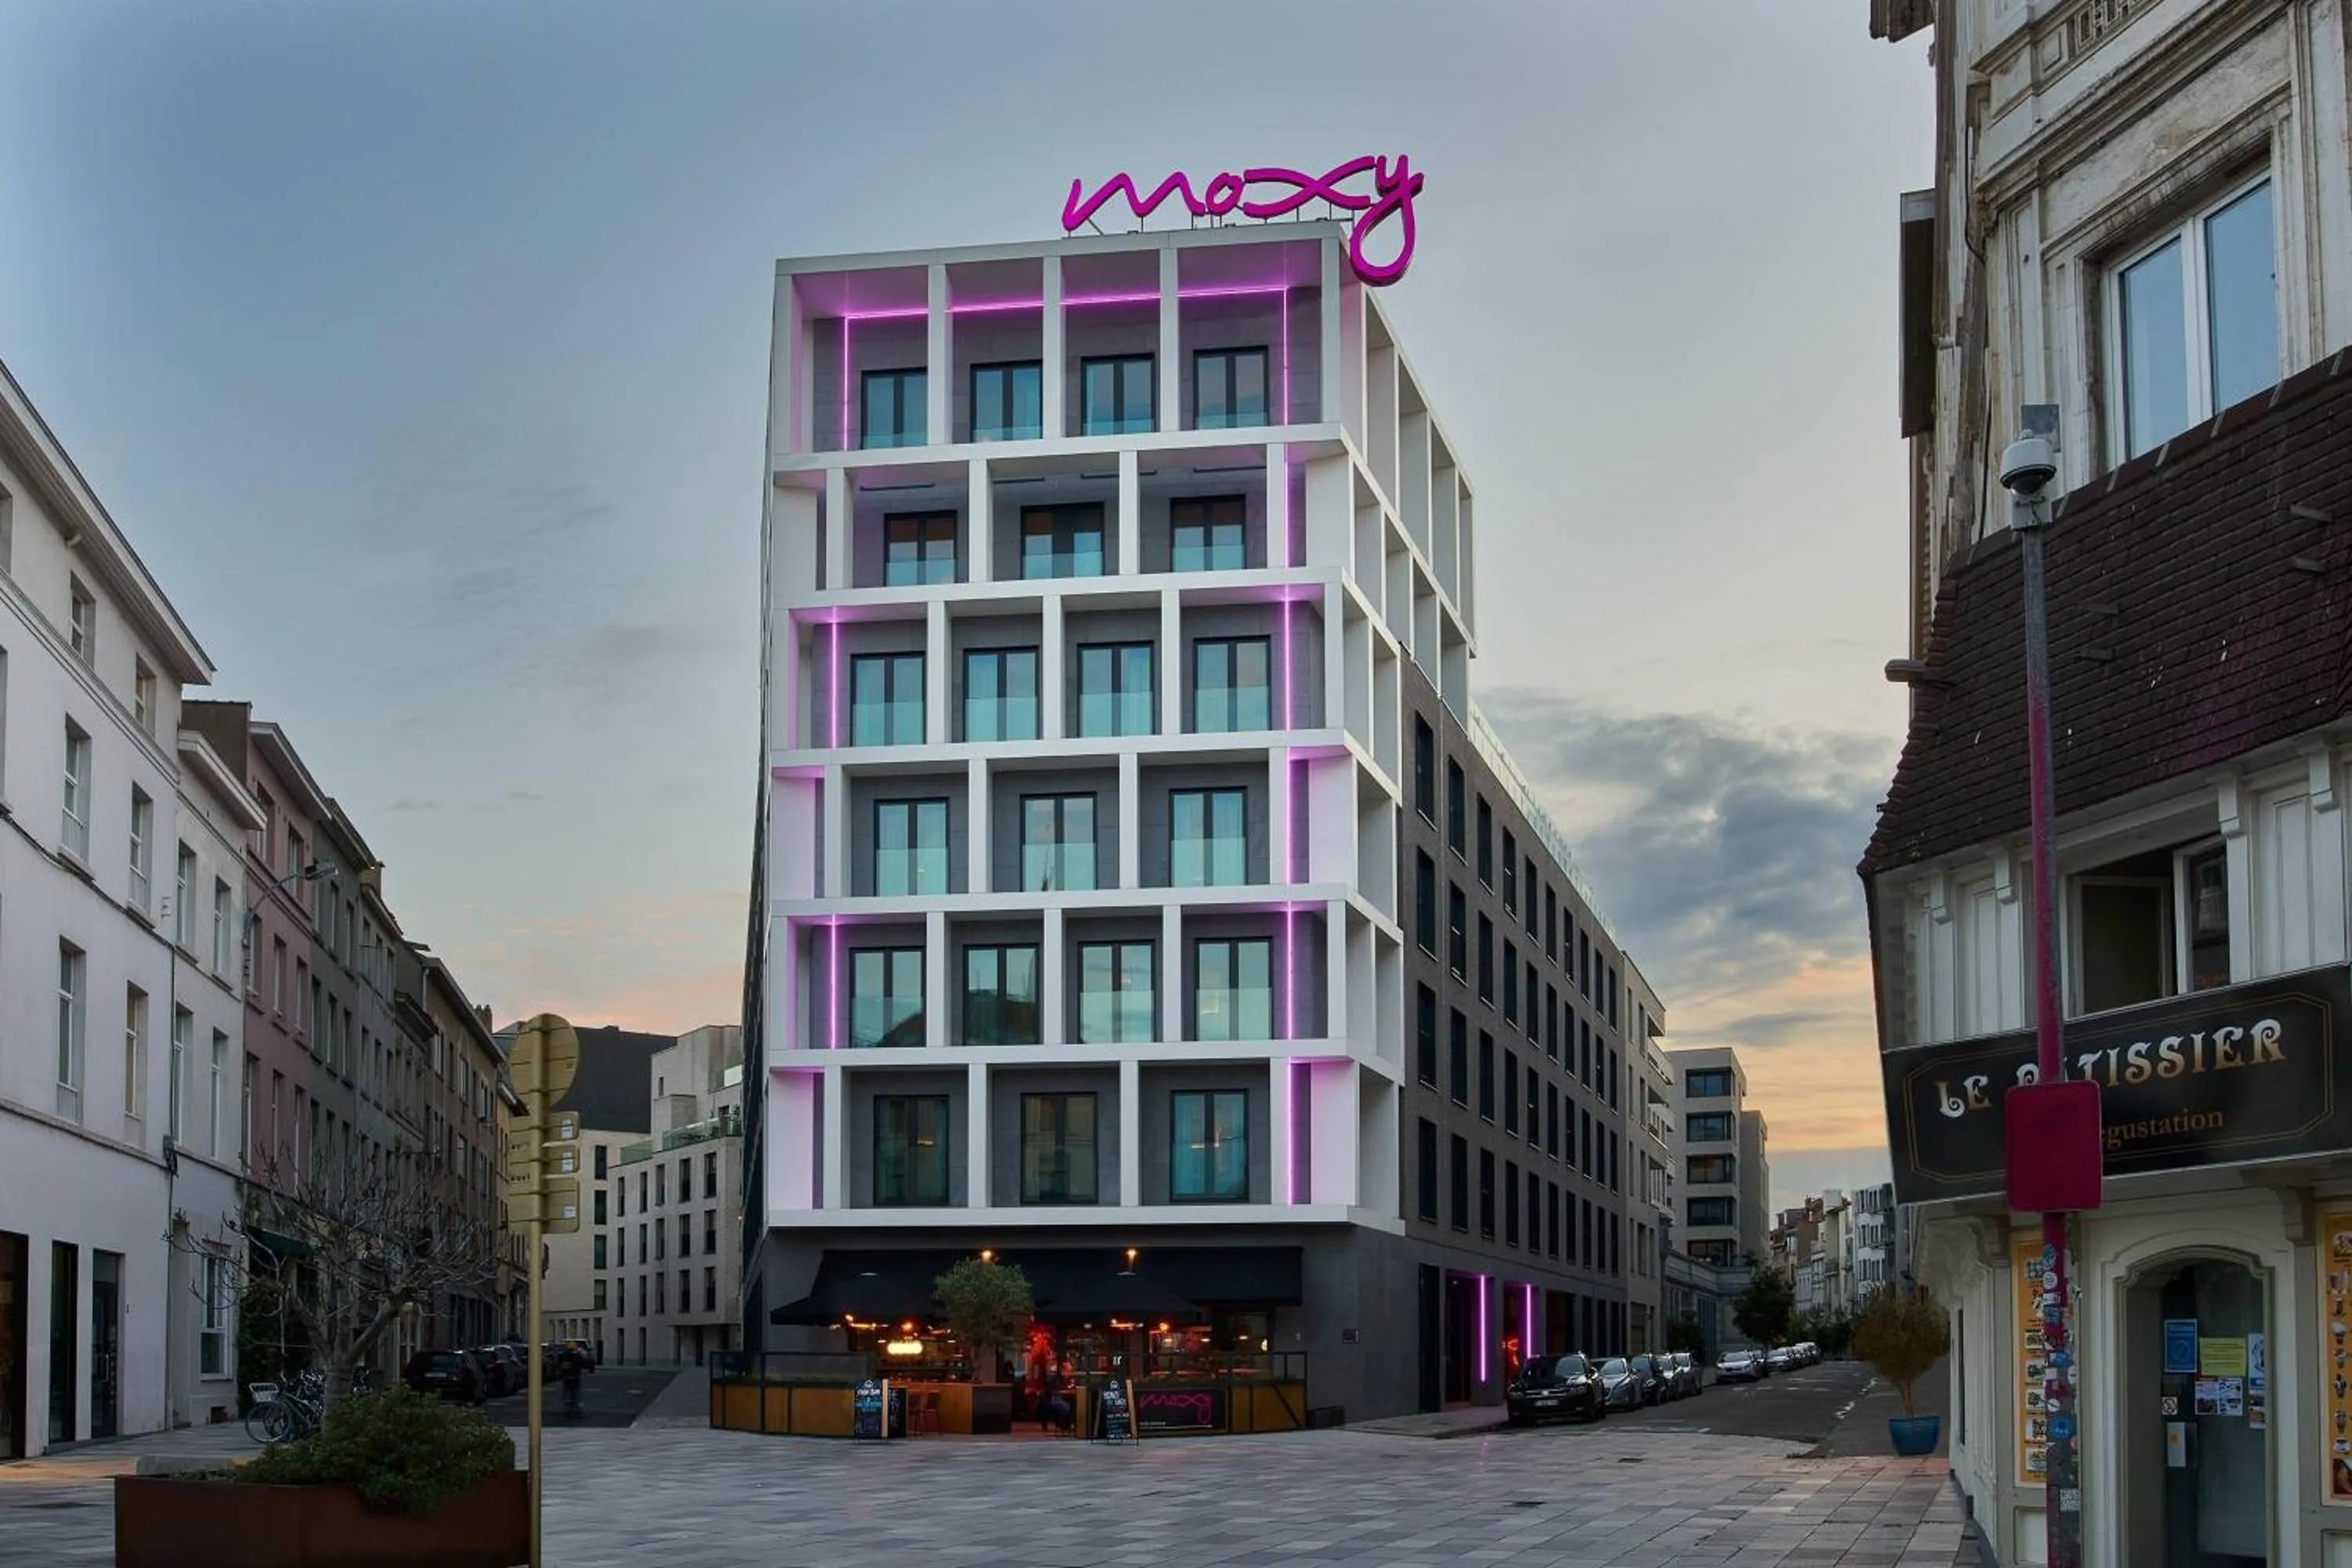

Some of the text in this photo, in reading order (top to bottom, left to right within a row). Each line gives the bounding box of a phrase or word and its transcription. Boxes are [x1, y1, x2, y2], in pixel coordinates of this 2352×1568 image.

[1062, 154, 1425, 287] moxy
[1935, 1018, 2286, 1119] LE PTISSIER
[2101, 1107, 2224, 1149] gustation
